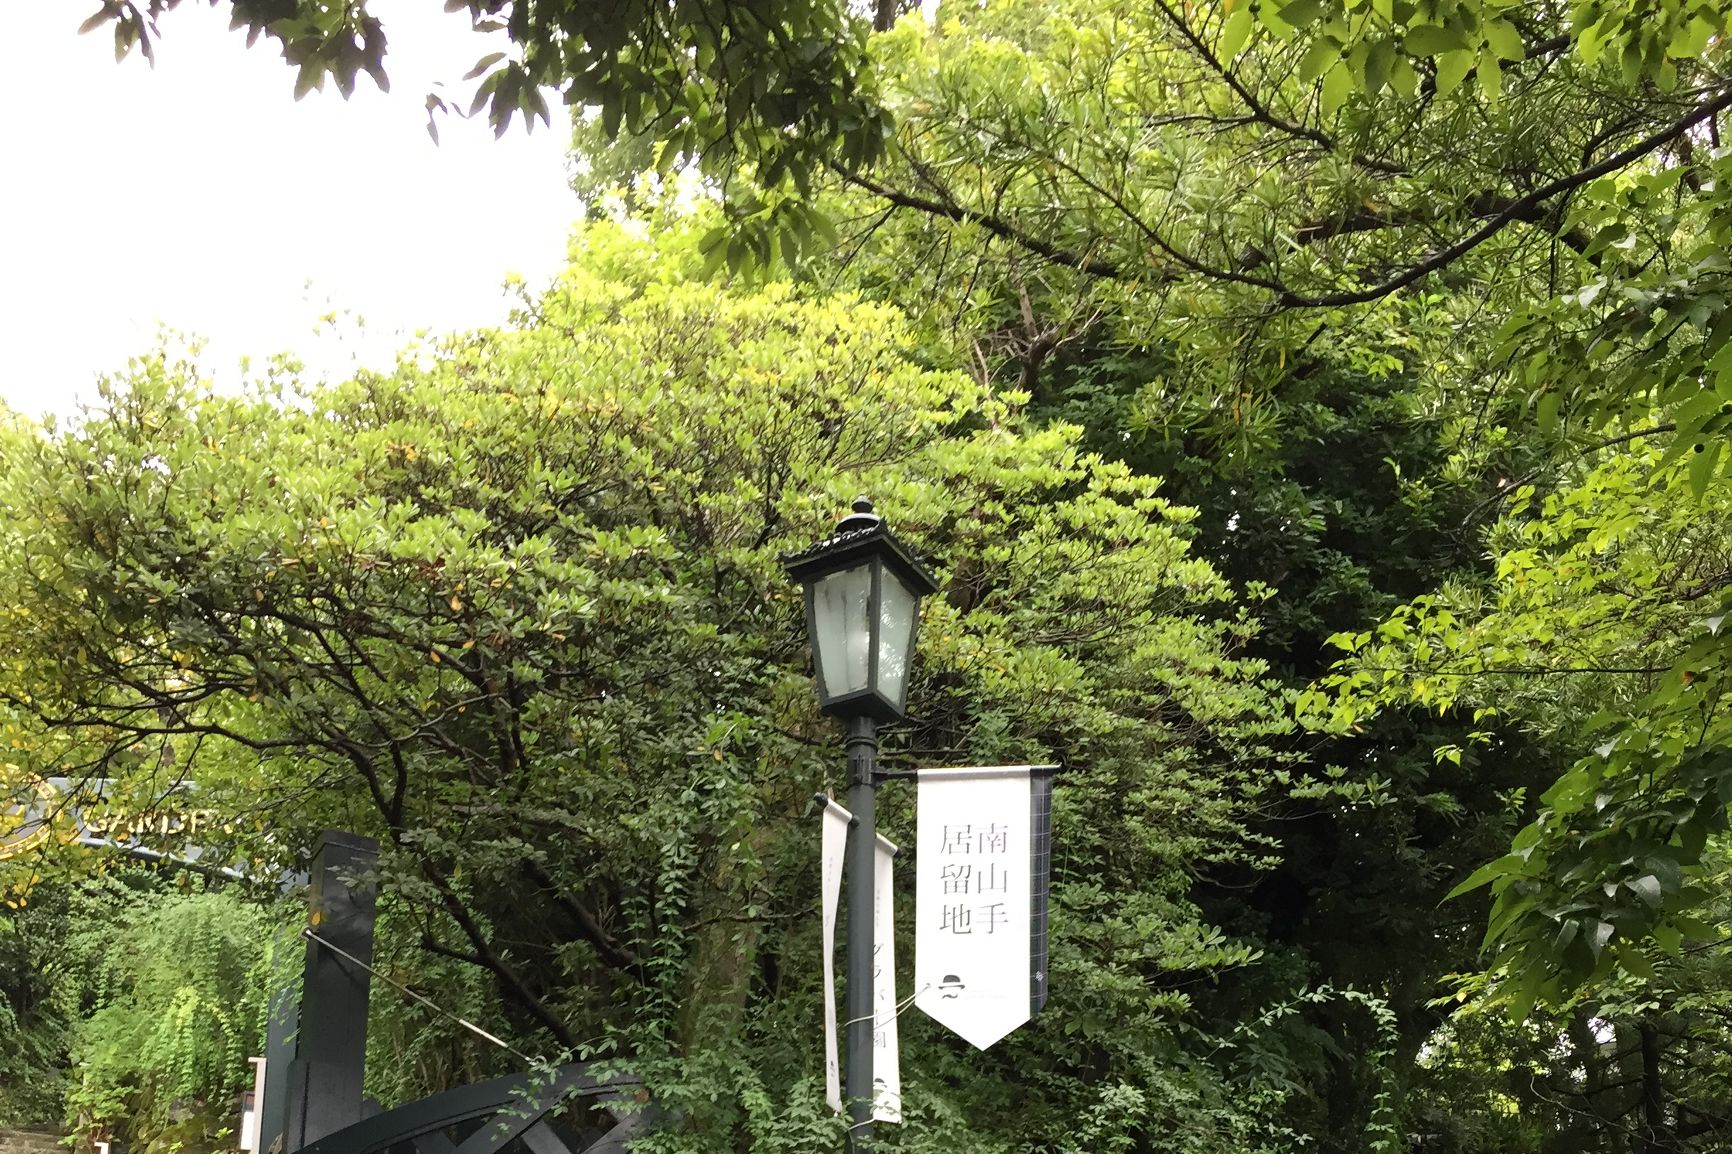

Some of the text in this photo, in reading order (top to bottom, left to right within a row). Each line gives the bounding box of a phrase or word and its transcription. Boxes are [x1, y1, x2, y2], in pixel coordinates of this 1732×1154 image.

[939, 823, 973, 936] 居留地
[976, 823, 1008, 935] 南山手
